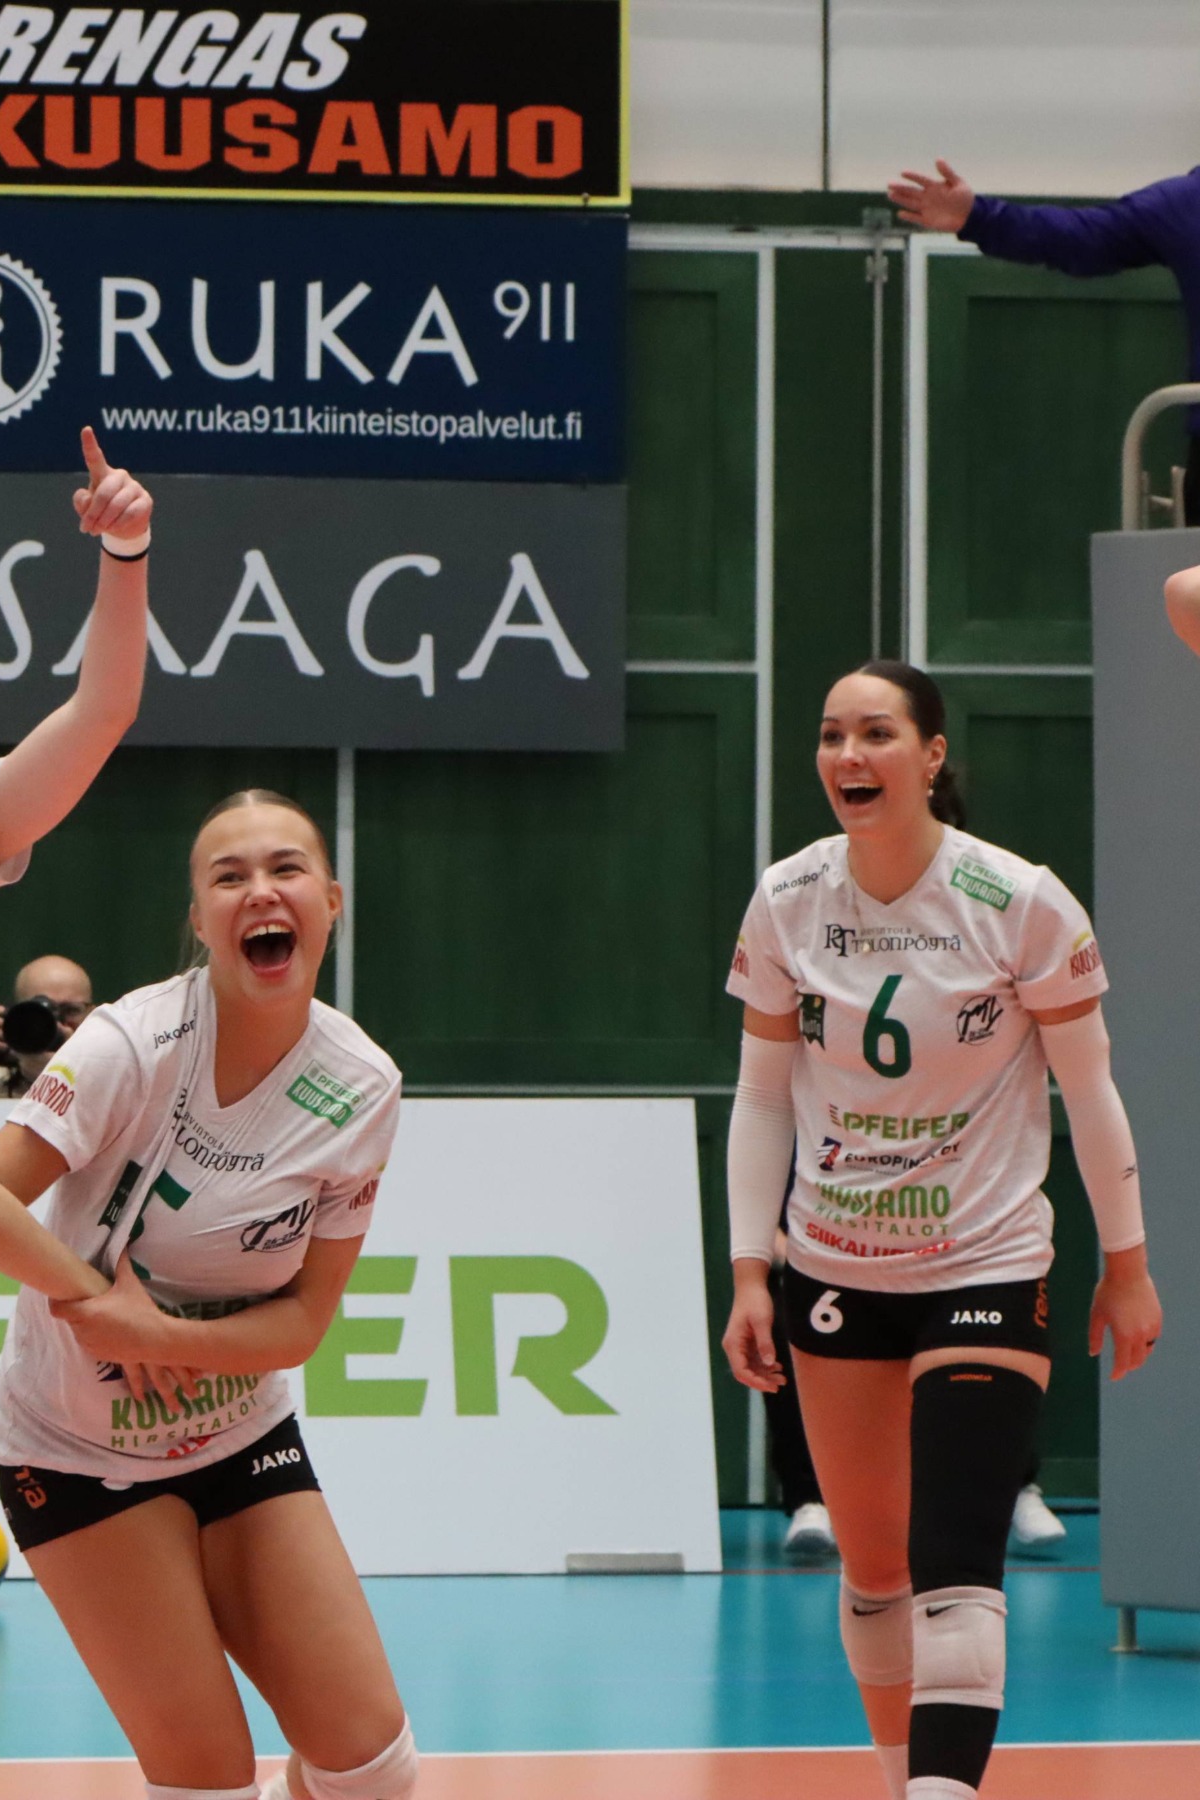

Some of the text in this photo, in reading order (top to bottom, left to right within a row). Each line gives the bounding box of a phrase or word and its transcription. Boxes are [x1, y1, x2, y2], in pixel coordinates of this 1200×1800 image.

[99, 277, 576, 387] RUKA 911
[102, 404, 583, 443] www.ruka911kiinteistopalvelut.fi
[863, 974, 912, 1079] 6
[810, 1289, 844, 1335] 6
[950, 1310, 1003, 1325] JAKO
[251, 1447, 301, 1475] JAKO
